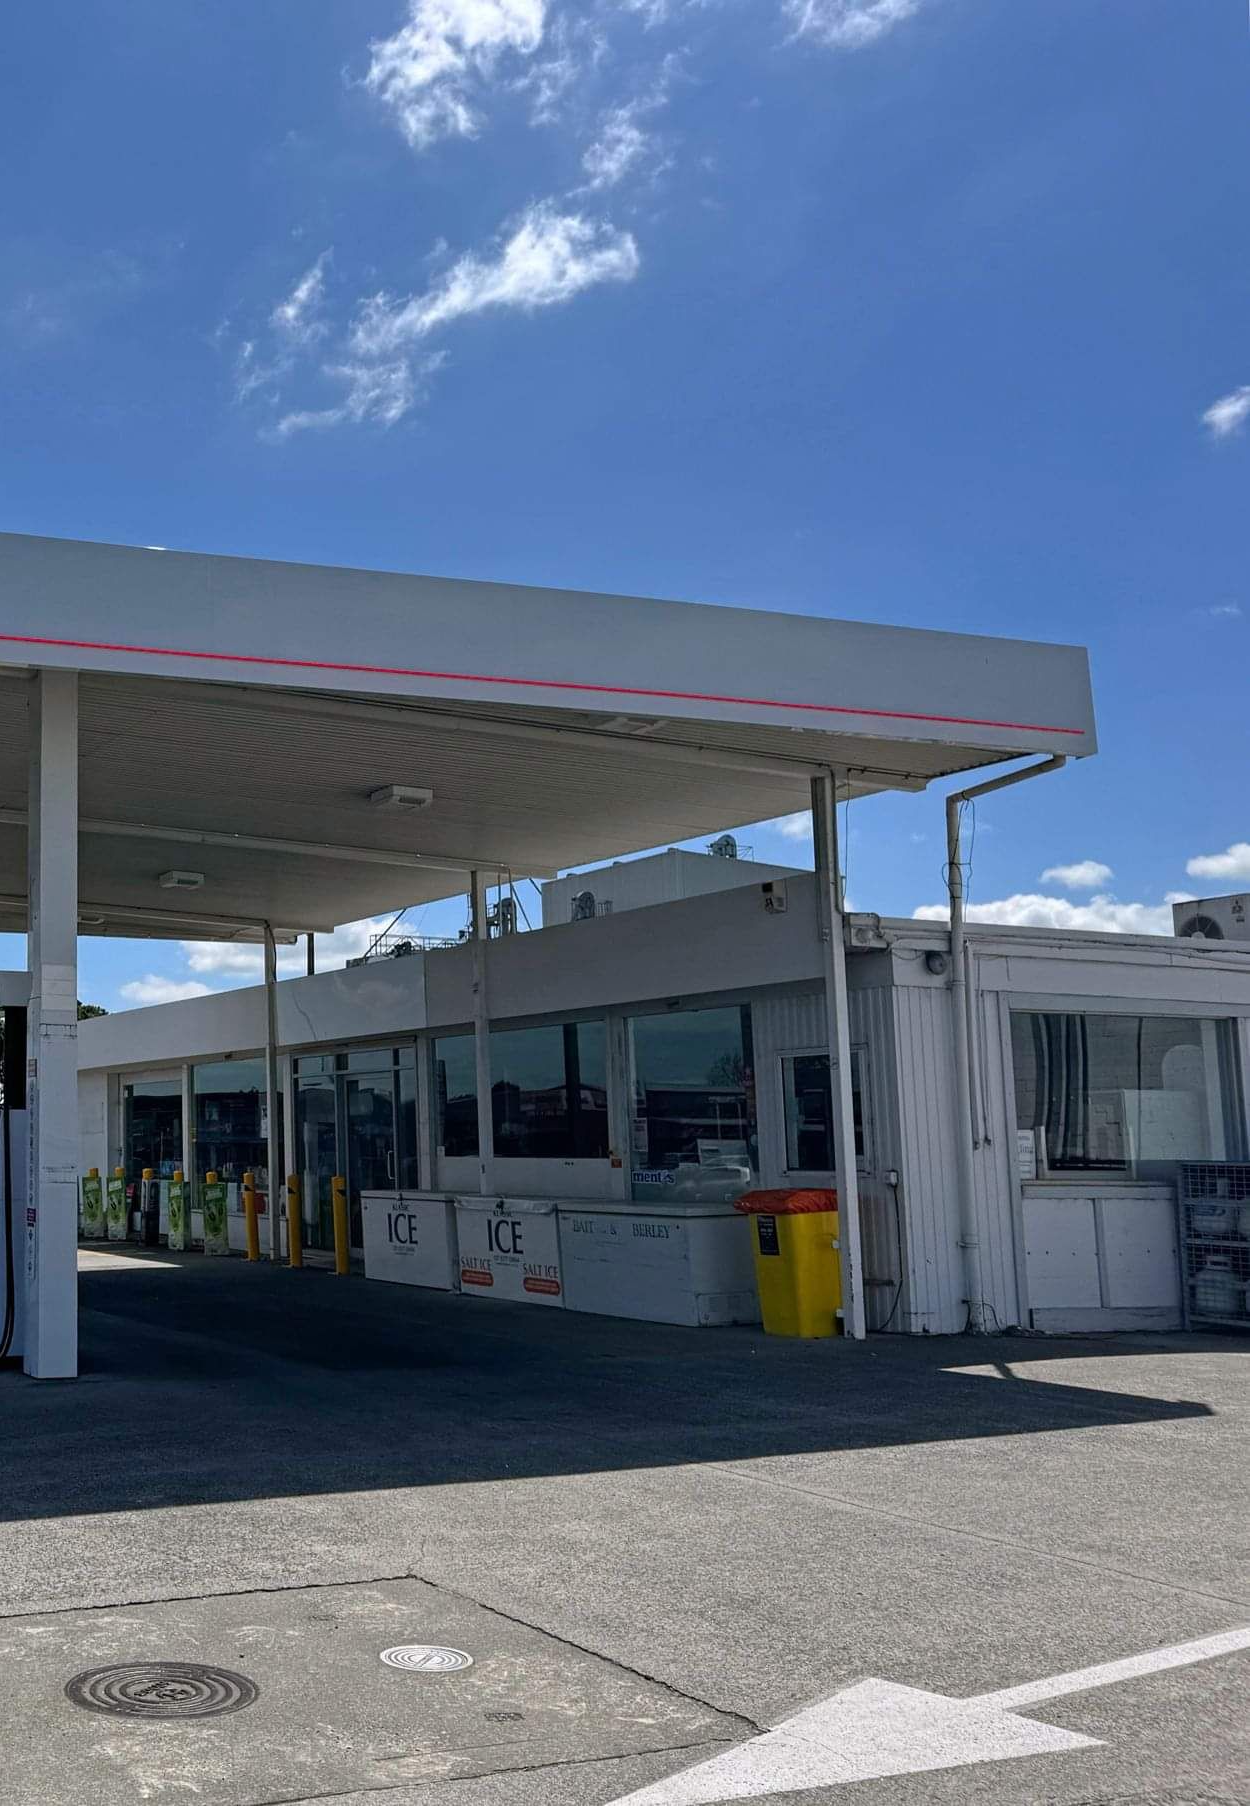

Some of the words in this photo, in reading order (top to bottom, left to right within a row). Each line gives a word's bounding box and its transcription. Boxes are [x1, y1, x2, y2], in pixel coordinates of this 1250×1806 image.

[387, 1213, 418, 1245] ICE
[487, 1219, 523, 1254] ICE
[461, 1256, 477, 1269] SALT
[479, 1258, 491, 1271] ICE
[523, 1263, 542, 1277] SALT
[543, 1265, 558, 1279] ICE
